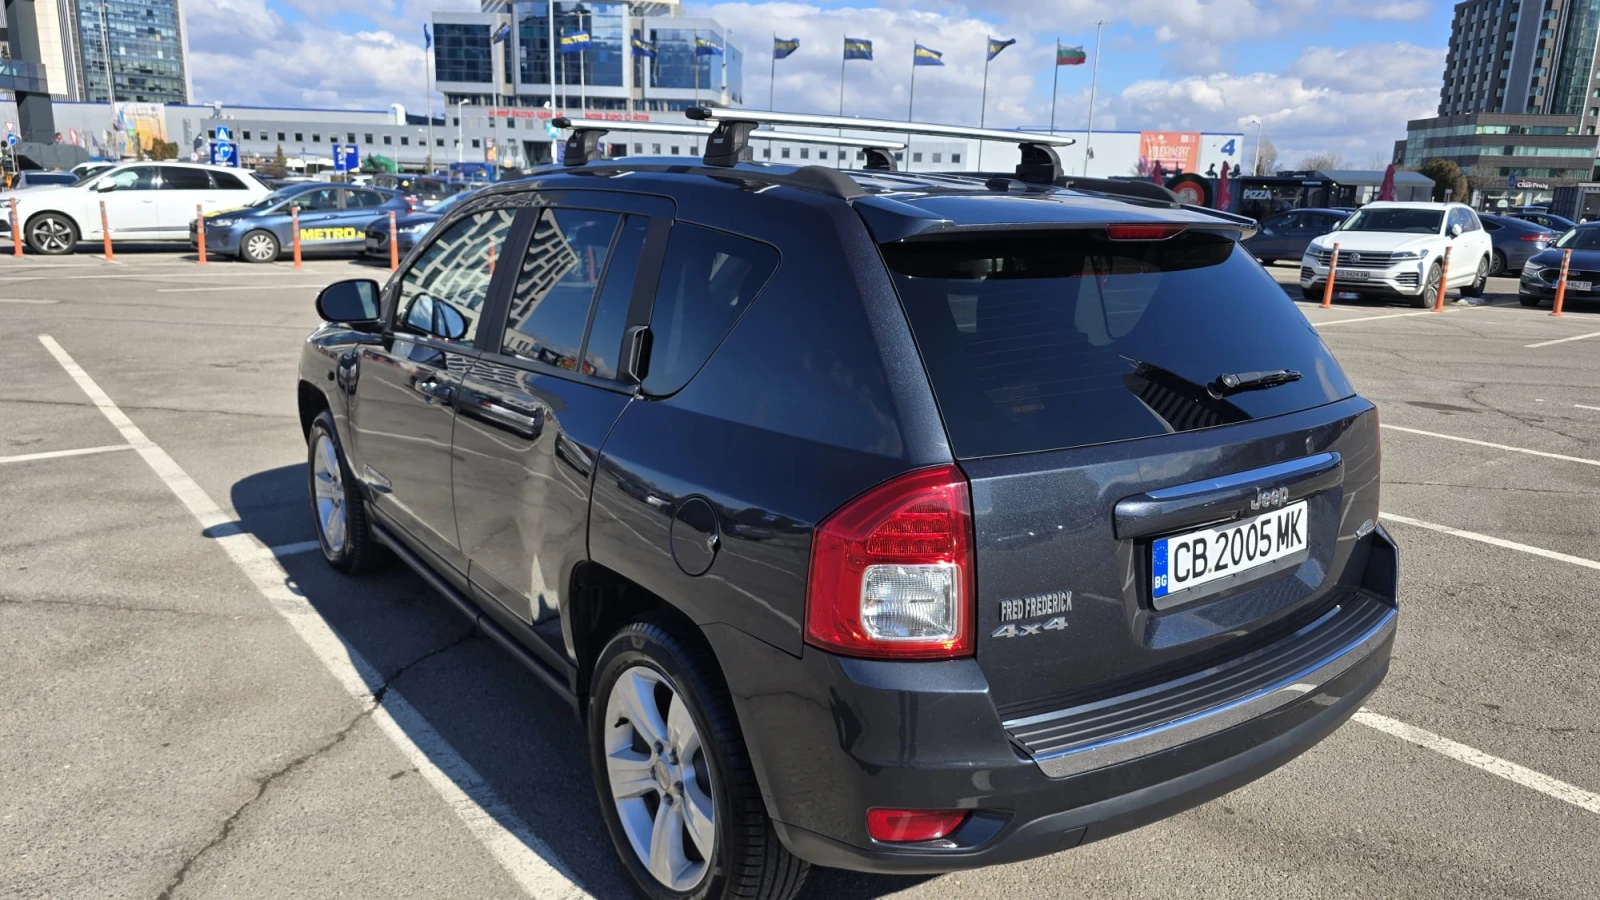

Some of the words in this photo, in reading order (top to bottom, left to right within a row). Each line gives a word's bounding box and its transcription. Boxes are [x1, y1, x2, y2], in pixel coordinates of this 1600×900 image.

[1220, 139, 1236, 156] 4
[1243, 189, 1272, 200] PIZZA
[1251, 486, 1289, 511] Jeep
[1214, 518, 1272, 572] 2005
[1276, 508, 1302, 553] MK
[1154, 574, 1168, 589] BG
[1001, 600, 1024, 622] FRED
[1025, 590, 1073, 618] FREDERICK
[991, 616, 1069, 638] 4x4
